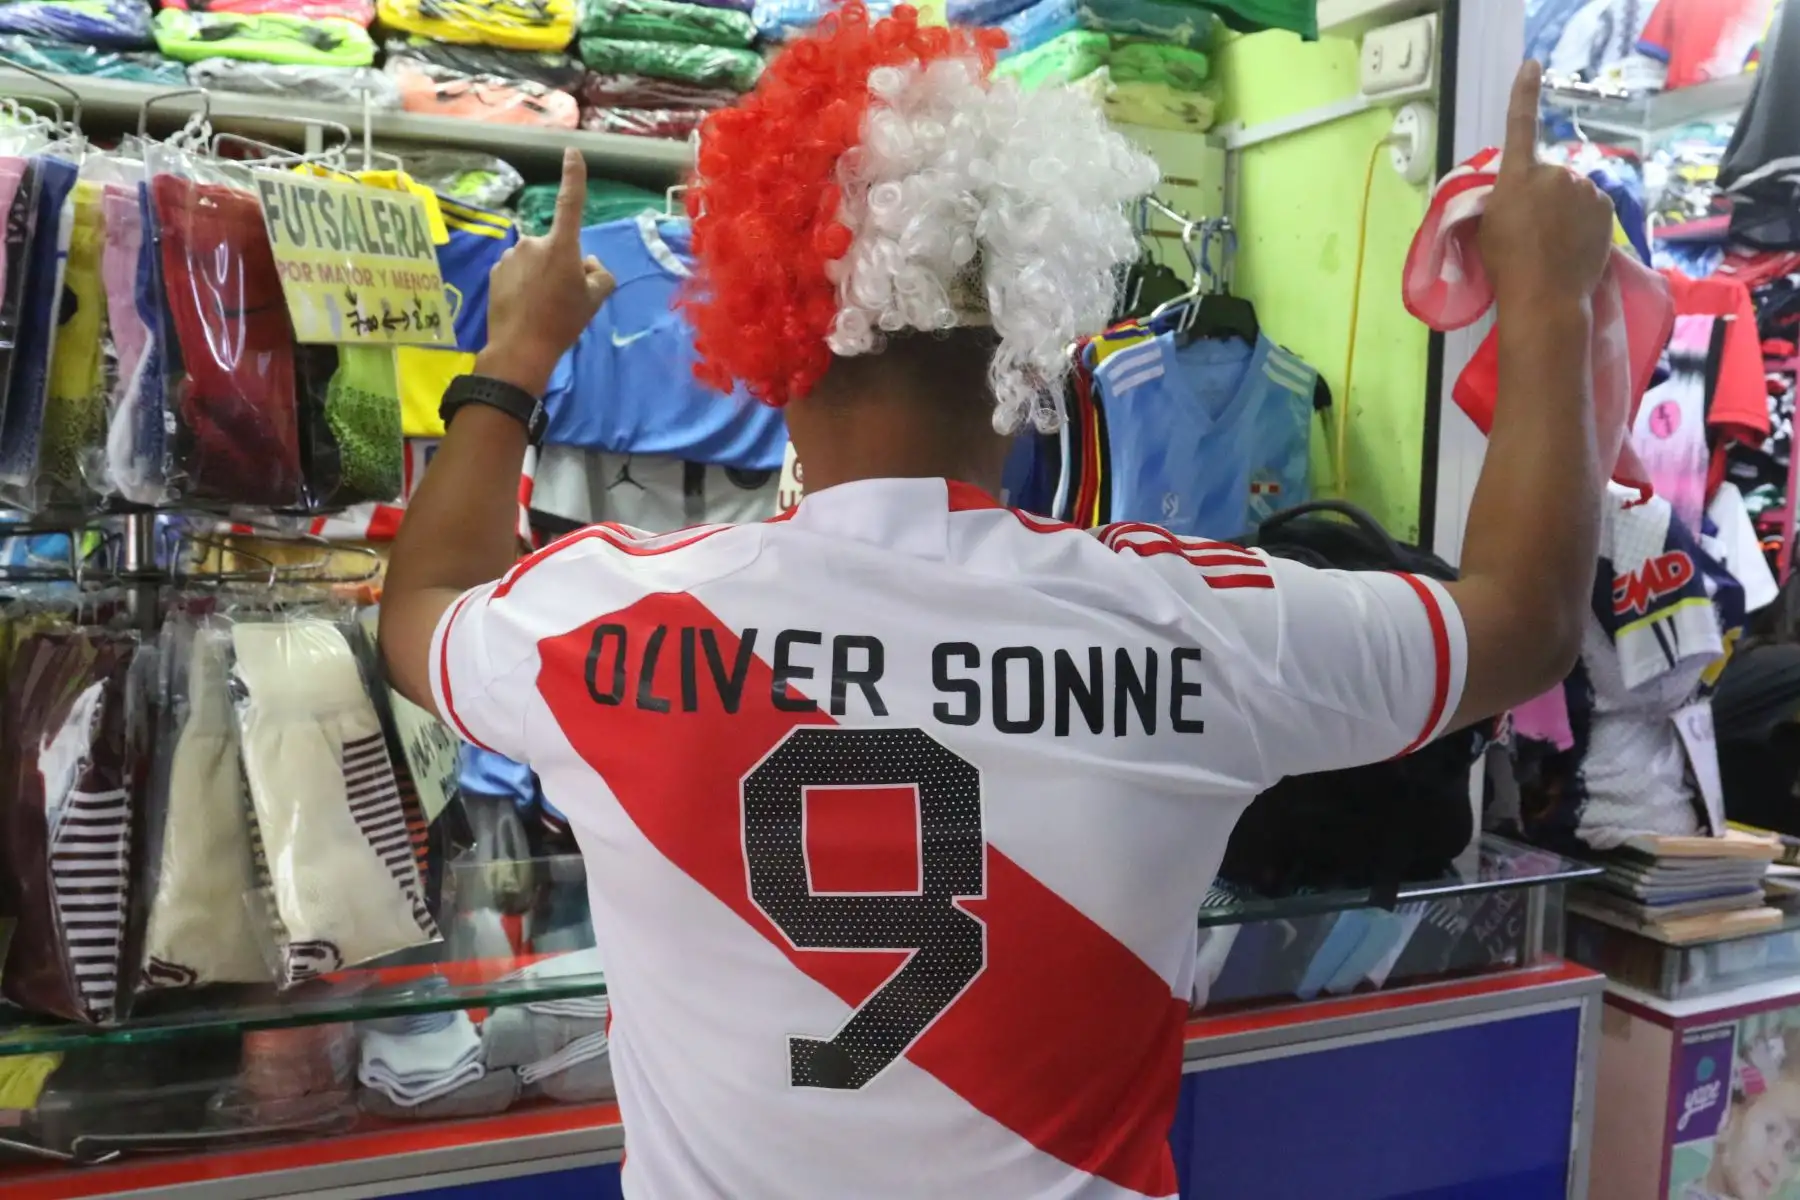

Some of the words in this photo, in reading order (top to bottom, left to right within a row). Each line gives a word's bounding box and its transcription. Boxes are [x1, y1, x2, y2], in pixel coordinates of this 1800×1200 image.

[258, 179, 432, 260] FUTSALERA
[277, 259, 313, 283] POR
[317, 263, 375, 287] MAYOR
[377, 270, 387, 287] Y
[390, 270, 441, 291] MENOR
[584, 624, 889, 716] OLIVER
[932, 642, 1204, 737] SONNE
[739, 724, 987, 1090] 9
